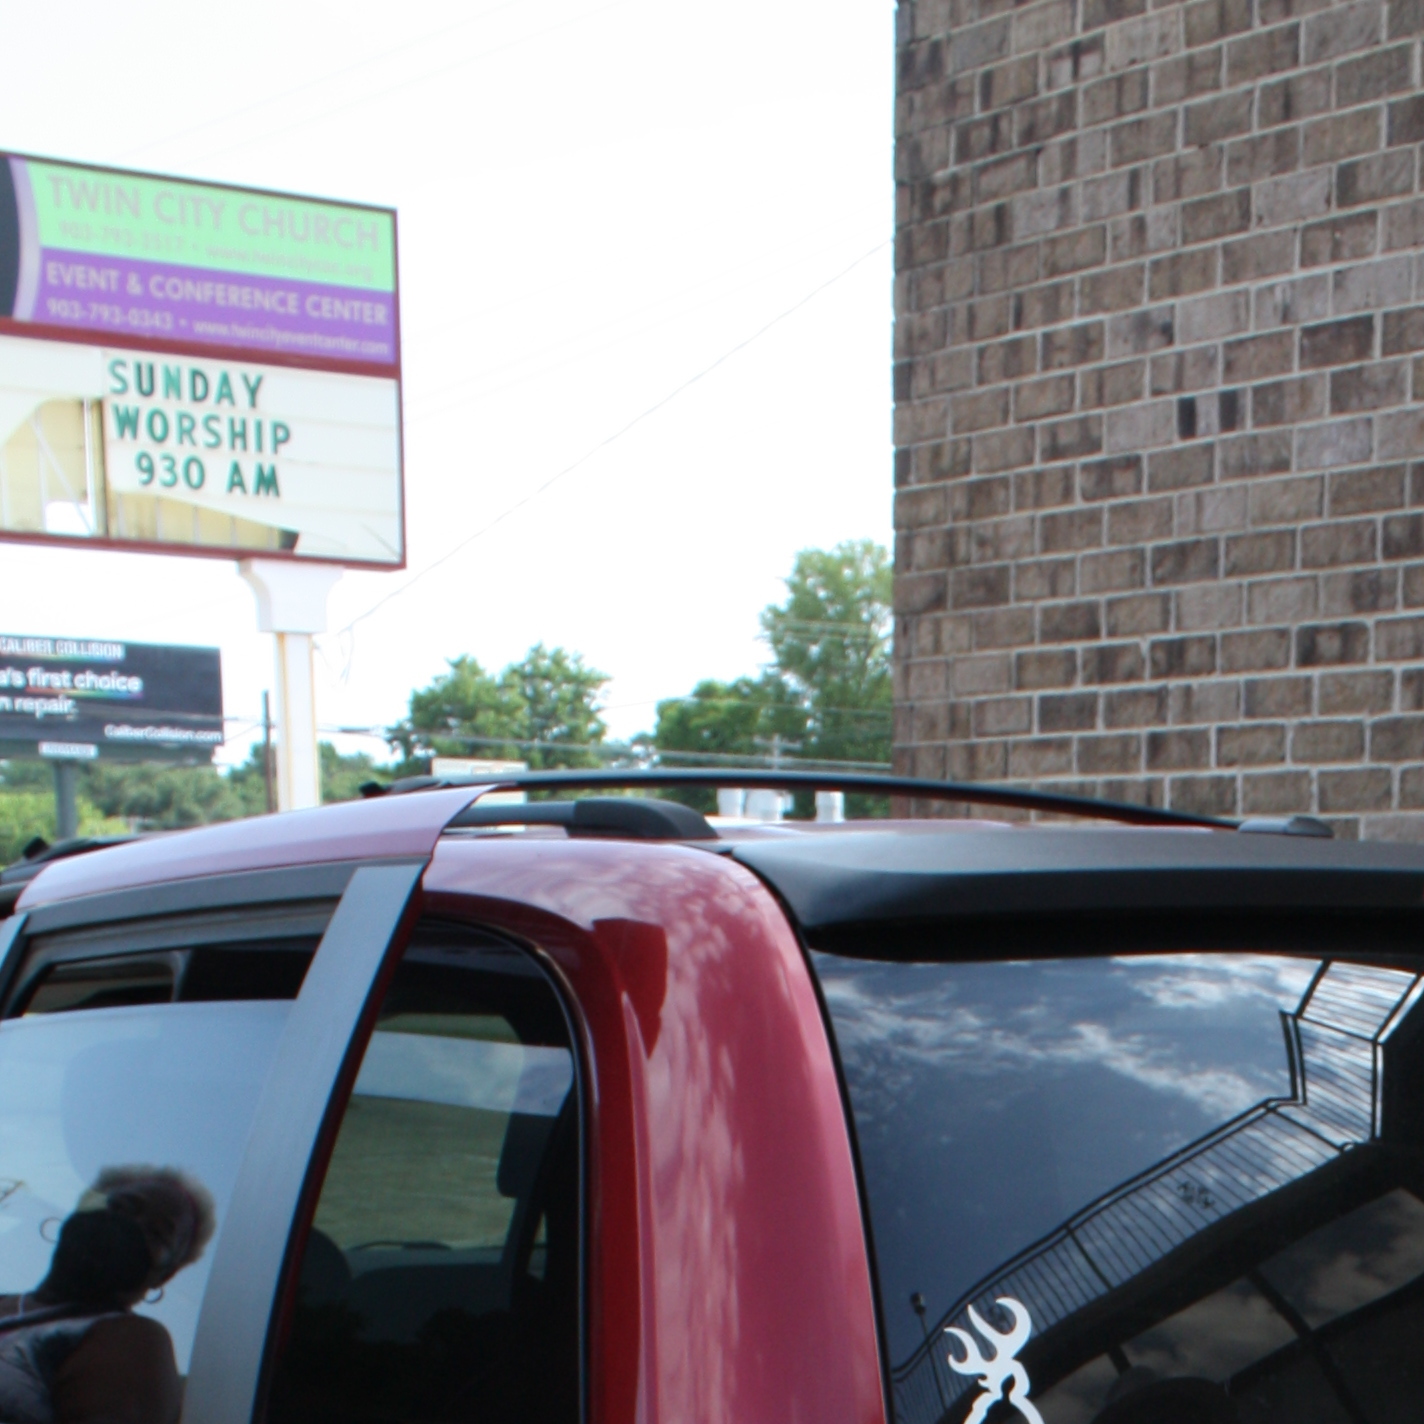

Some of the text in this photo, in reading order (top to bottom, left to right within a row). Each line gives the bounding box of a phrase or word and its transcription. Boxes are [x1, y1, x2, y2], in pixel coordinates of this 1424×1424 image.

[46, 174, 380, 253] TWIN CITY CHURCH
[46, 261, 389, 327] EVENT & CONFERENCE CENTER
[107, 358, 266, 409] SUNDAY
[111, 404, 292, 456] WORSHIP
[134, 451, 282, 499] 930 AM
[56, 639, 123, 659] COLLISION
[26, 667, 73, 688] first
[74, 670, 143, 693] choice
